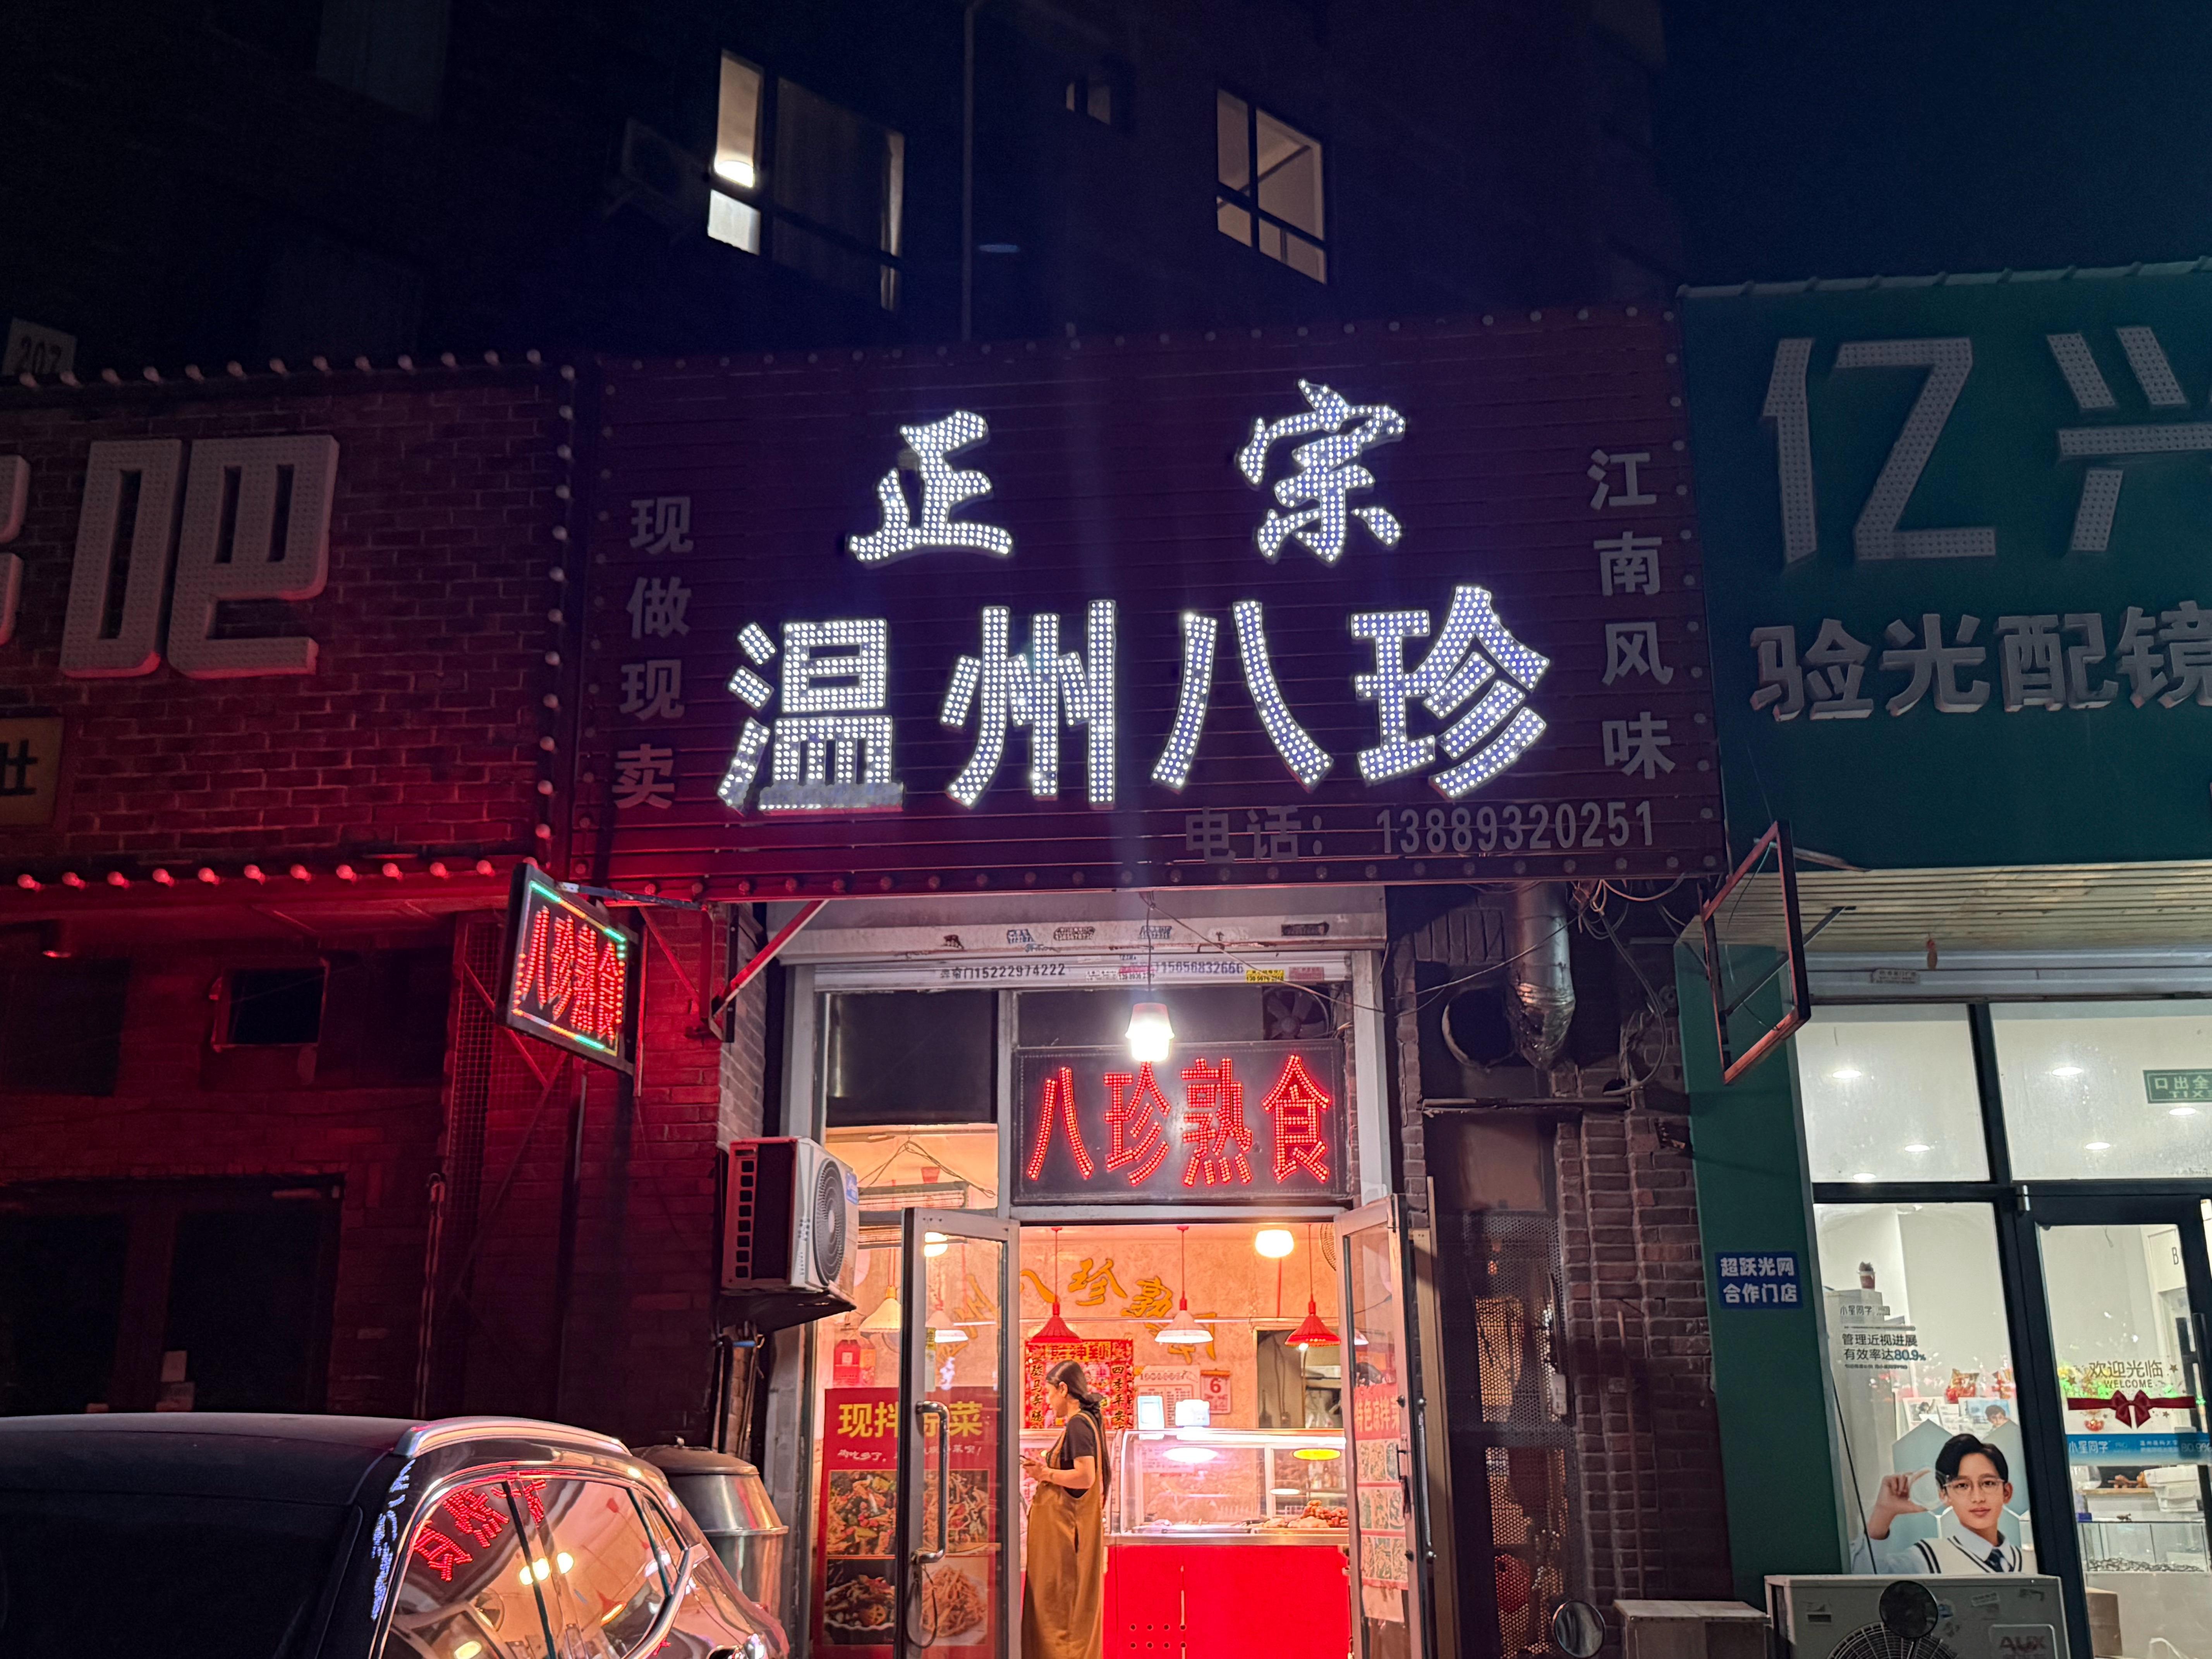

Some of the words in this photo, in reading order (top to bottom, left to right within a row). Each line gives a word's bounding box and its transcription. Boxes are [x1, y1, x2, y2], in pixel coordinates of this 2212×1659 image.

[0, 433, 340, 680] 吧
[1587, 448, 1675, 780] 江南风味
[611, 496, 694, 810] 现做现卖
[1748, 599, 2212, 722] 验光配镜
[716, 585, 1550, 816] 温州八珍
[1376, 801, 1654, 853] 13889320251
[521, 905, 620, 1046] 八珍熟食
[1026, 1054, 1331, 1187] 八珍熟食
[1720, 1257, 1795, 1278] 超跃光网
[1723, 1283, 1798, 1304] 合作门店
[1842, 1333, 1918, 1347] 管理近视进展
[1843, 1348, 1927, 1361] 有效率达80.9%
[1210, 1377, 1221, 1393] 6
[2088, 1360, 2164, 1378] 欢迎光临
[2104, 1379, 2153, 1388] WELCOME
